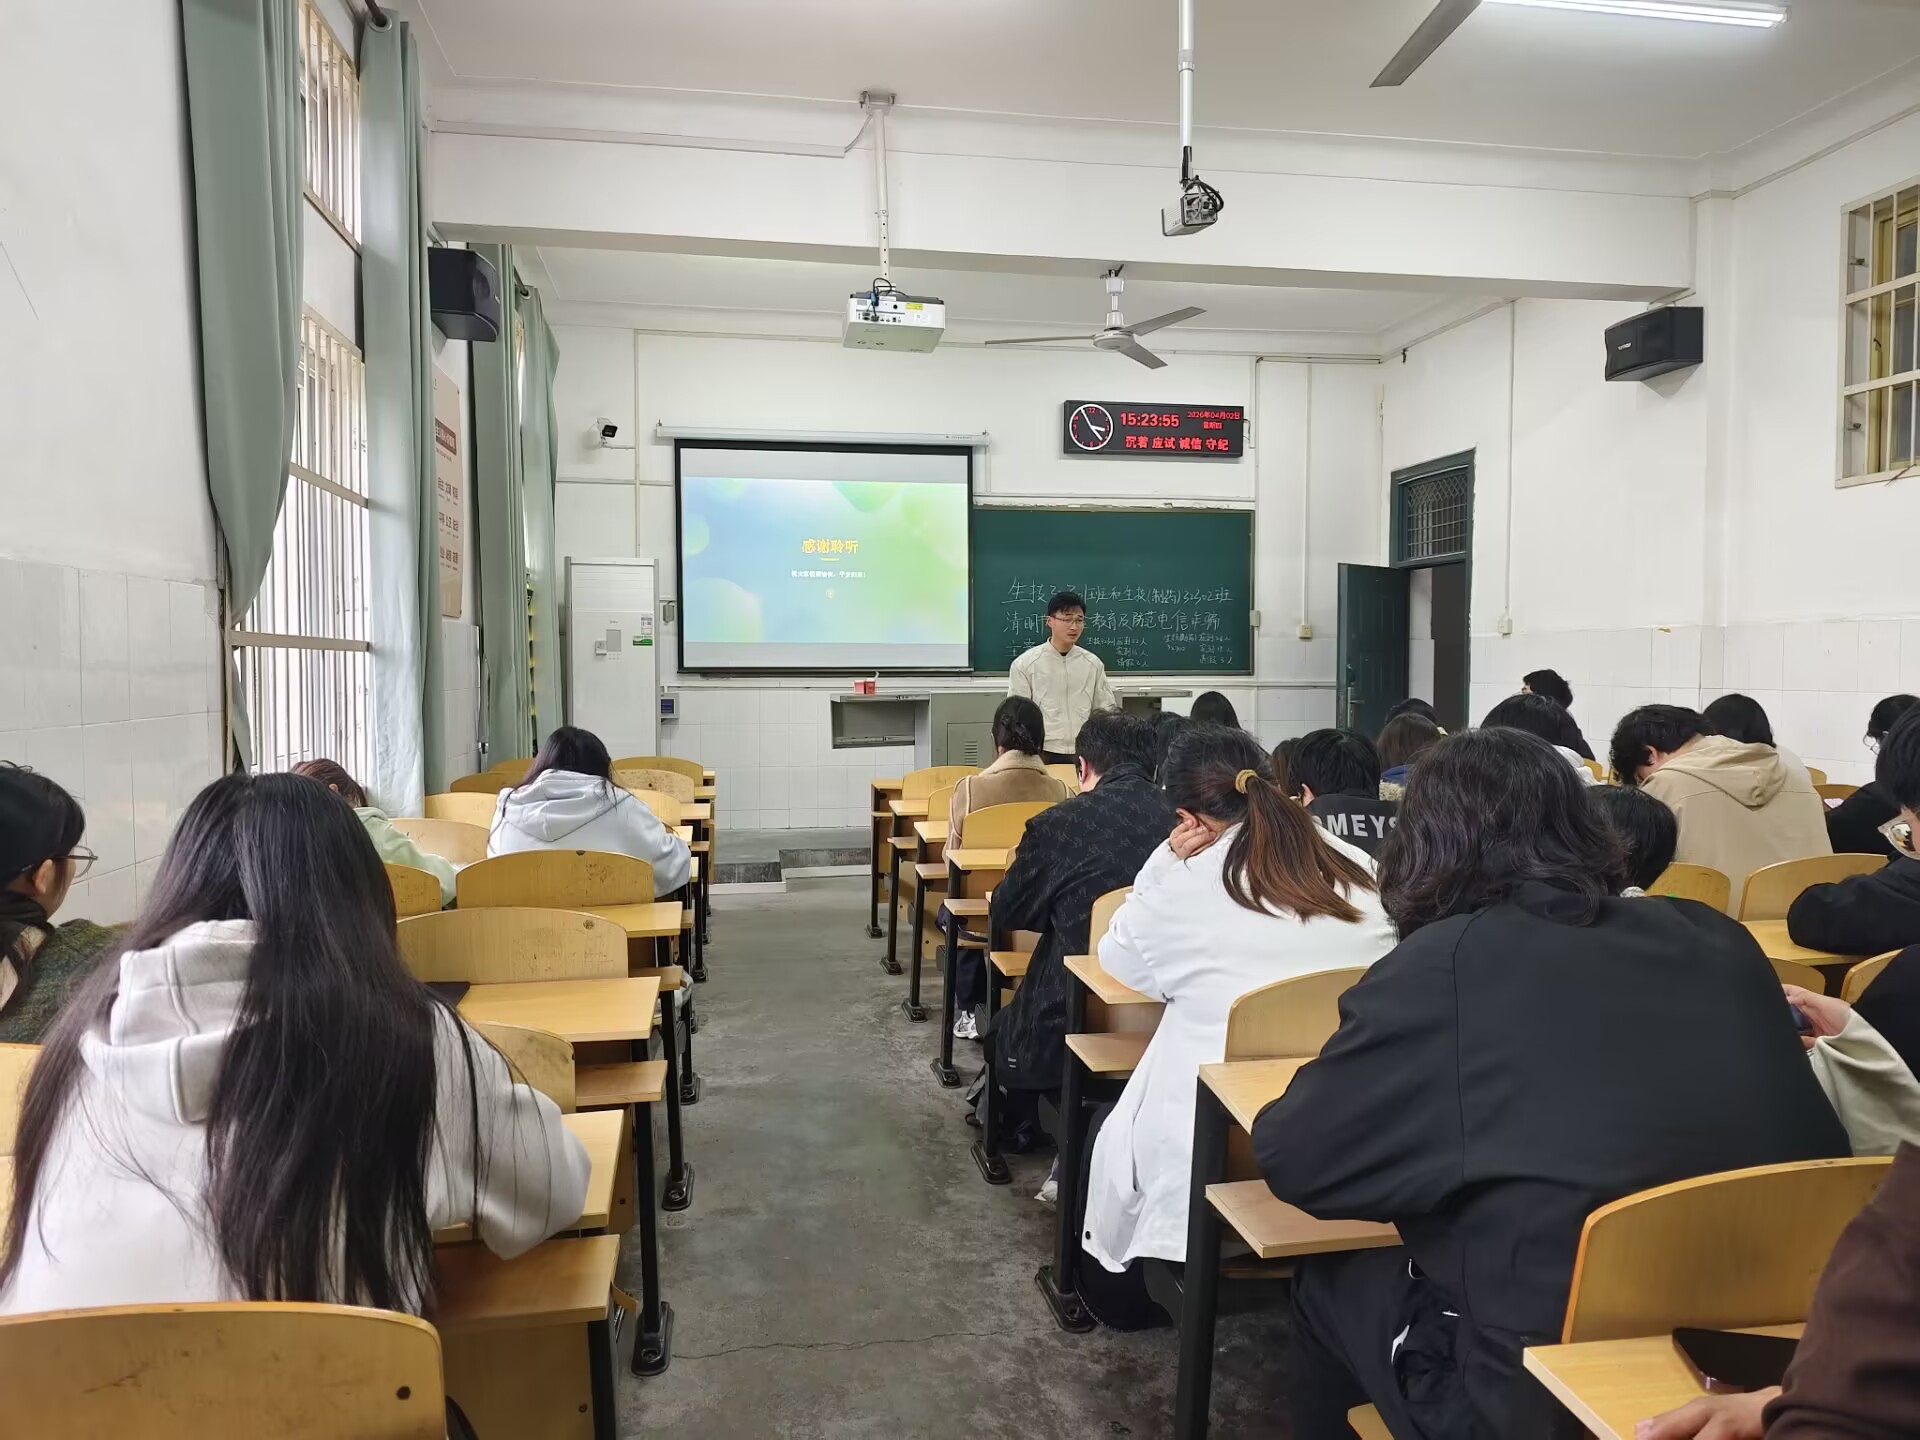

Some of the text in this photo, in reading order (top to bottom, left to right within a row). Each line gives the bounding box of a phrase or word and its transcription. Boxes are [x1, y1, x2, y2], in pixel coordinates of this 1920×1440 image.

[1120, 413, 1180, 427] 15:23:55
[1187, 411, 1240, 420] 2026年04月02日
[1203, 421, 1223, 429] 星期四
[1125, 436, 1229, 450] 沉着 应试 诚信 守纪
[802, 538, 859, 553] 感谢聆听
